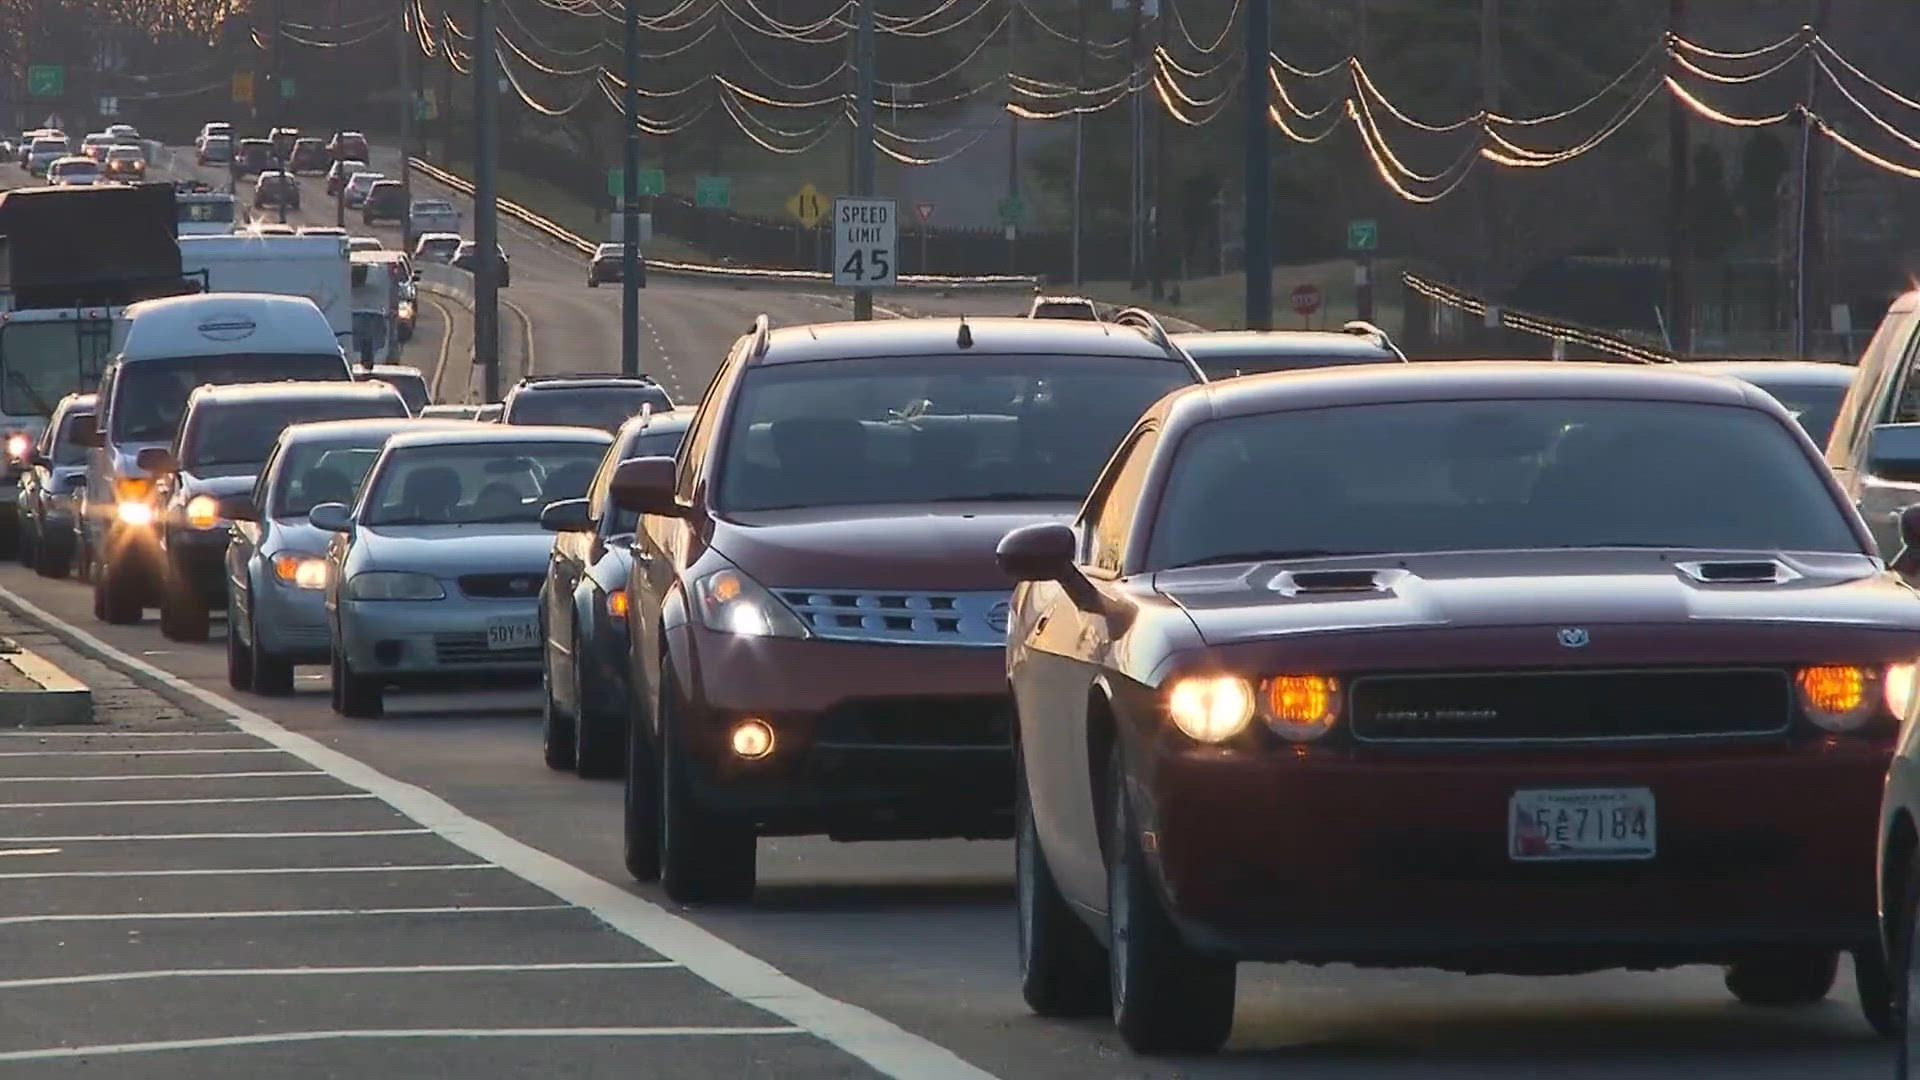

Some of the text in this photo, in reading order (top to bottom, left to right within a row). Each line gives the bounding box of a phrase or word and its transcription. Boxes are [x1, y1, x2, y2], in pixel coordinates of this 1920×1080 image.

[842, 206, 887, 223] SPEED
[849, 227, 882, 243] LIMIT
[842, 249, 889, 281] 45
